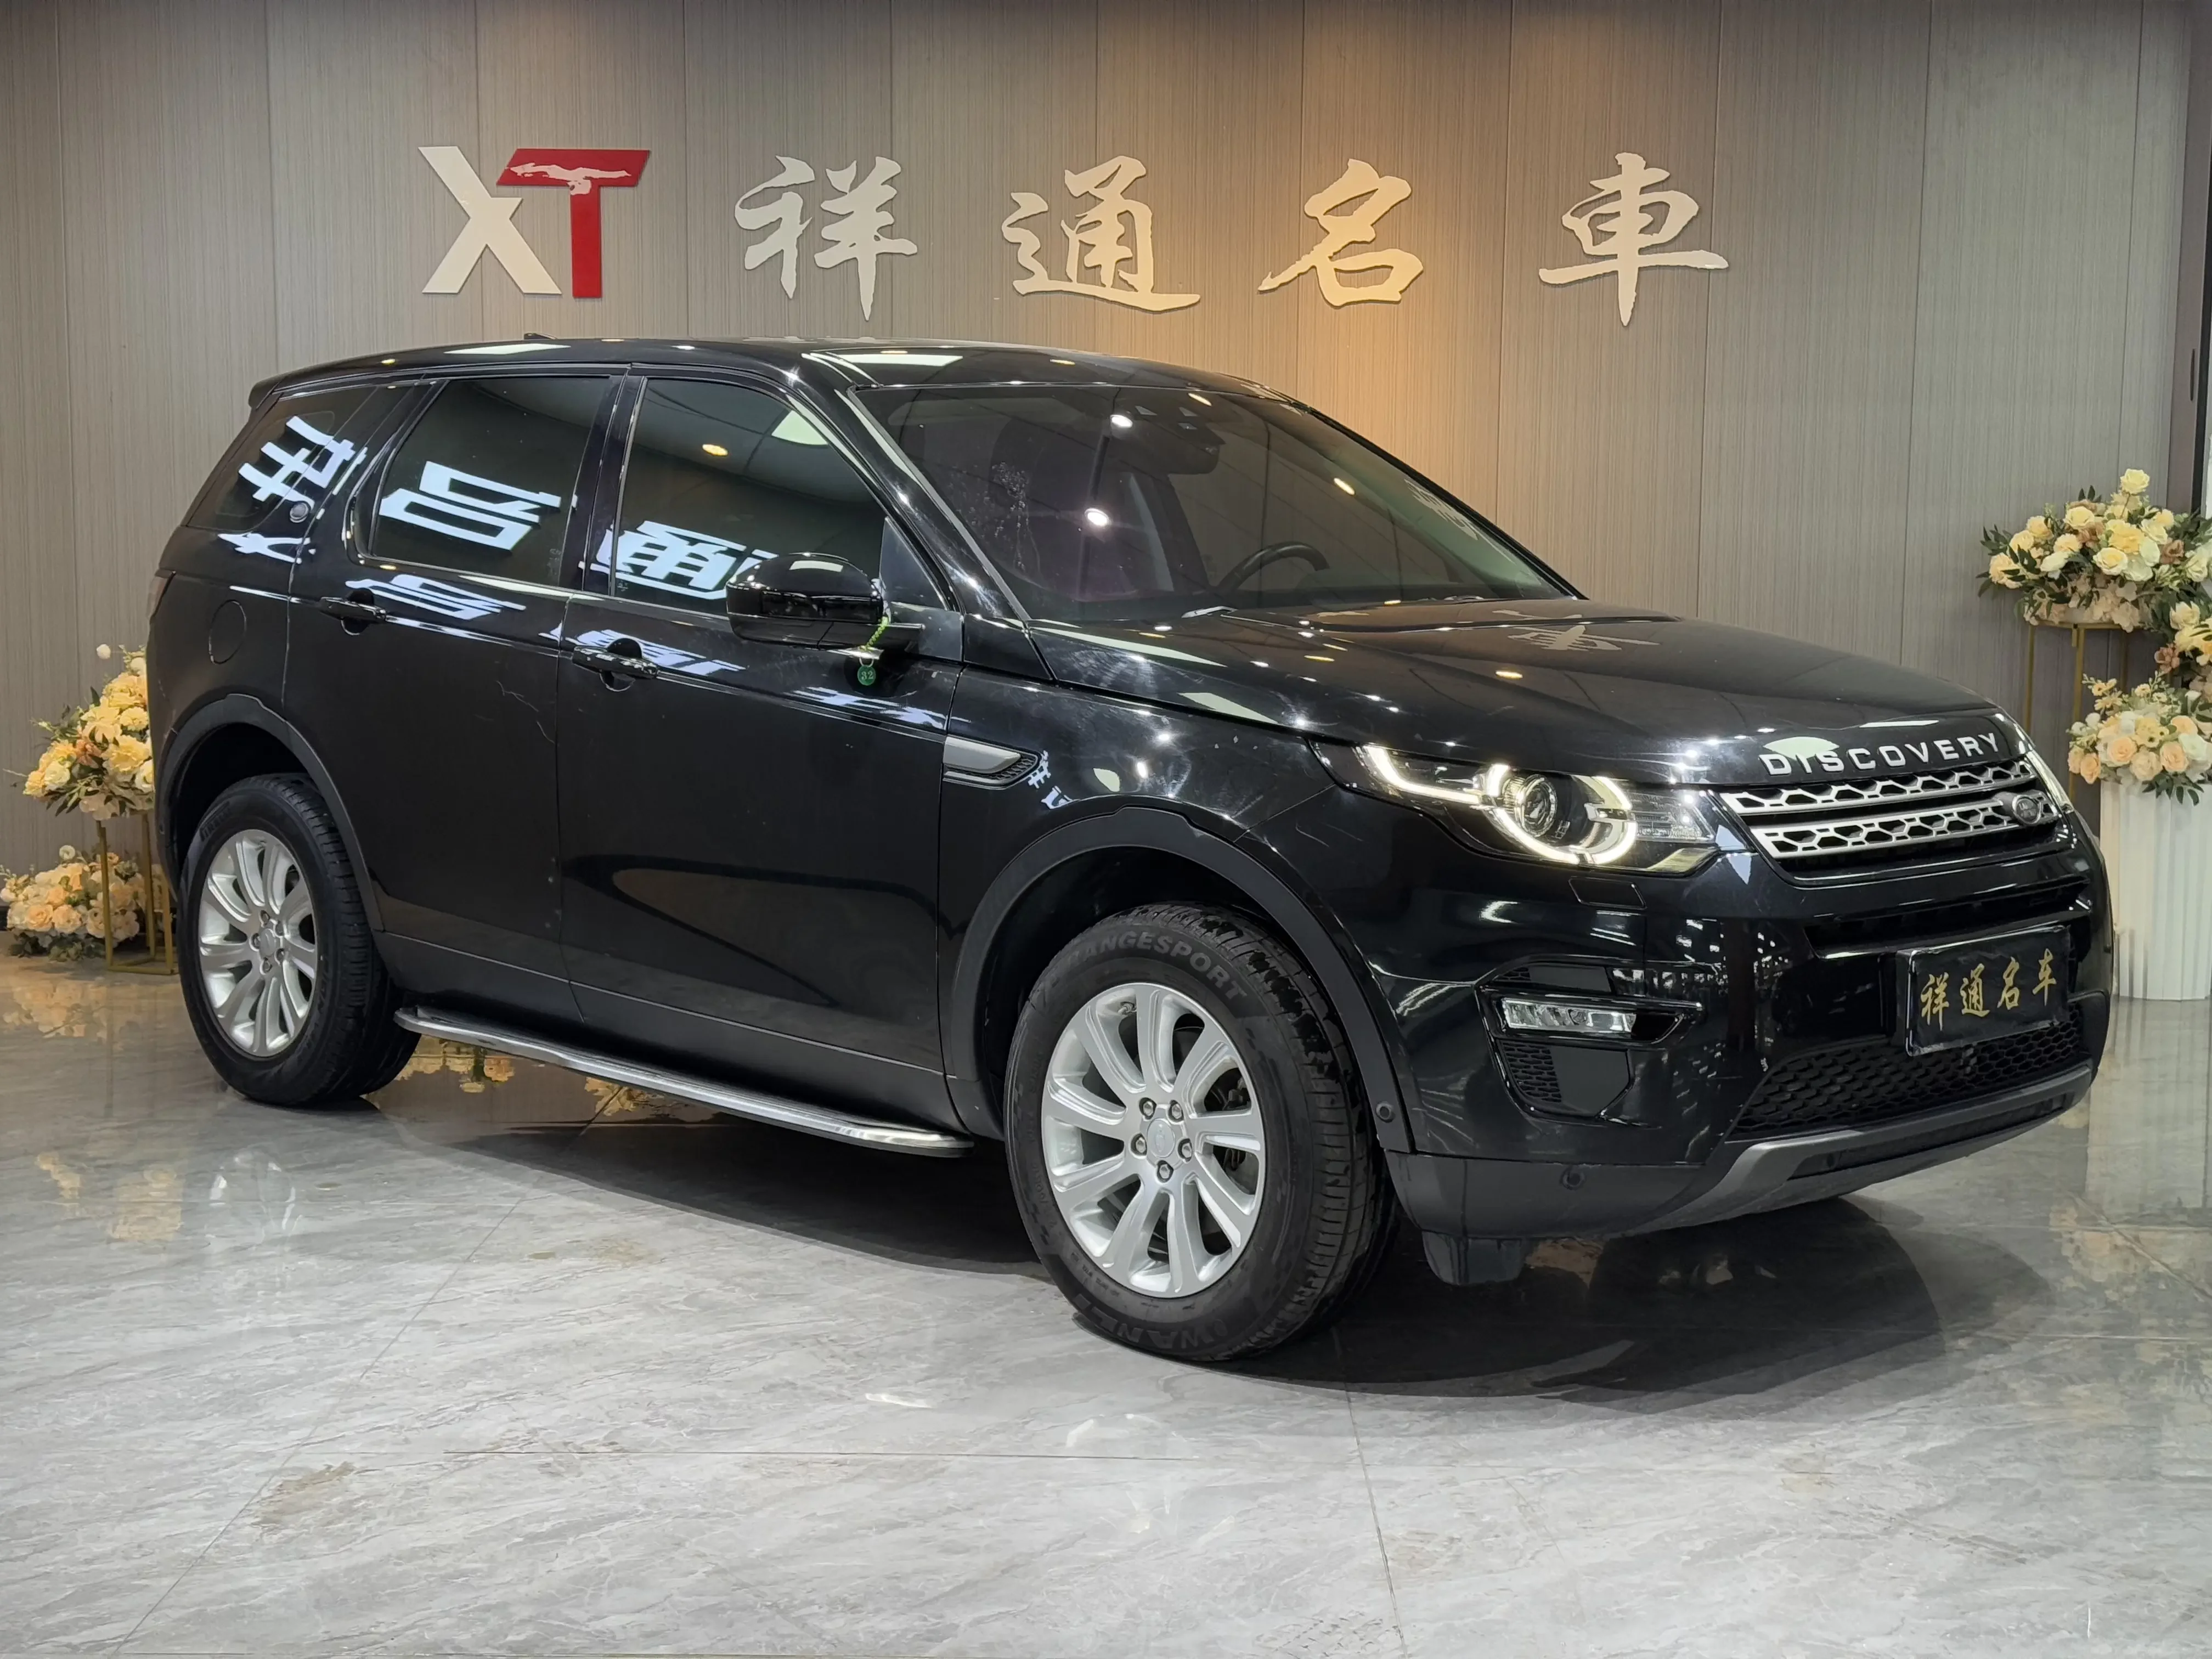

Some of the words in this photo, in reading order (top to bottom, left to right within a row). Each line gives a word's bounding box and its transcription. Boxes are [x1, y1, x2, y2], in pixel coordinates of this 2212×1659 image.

[419, 146, 651, 298] XT
[861, 671, 874, 680] 32
[1759, 732, 1999, 776] DISCOVERY
[1920, 948, 2057, 1031] 祥通名车
